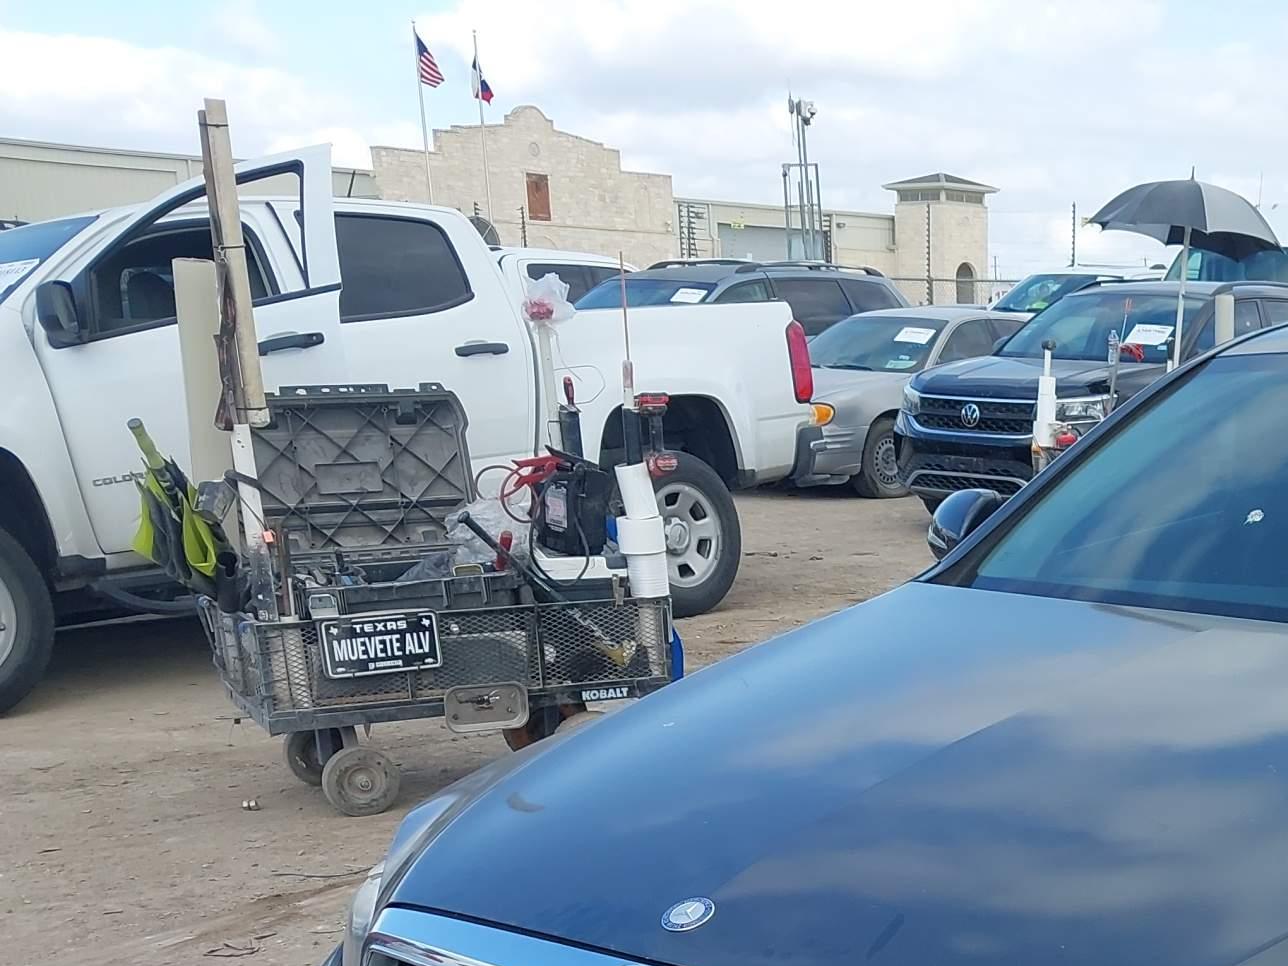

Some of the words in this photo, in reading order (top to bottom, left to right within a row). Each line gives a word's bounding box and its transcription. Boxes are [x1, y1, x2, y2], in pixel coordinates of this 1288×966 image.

[353, 620, 407, 633] TEXAS
[333, 634, 402, 661] MUEVETE
[405, 631, 430, 655] ALV
[581, 687, 629, 701] KOBALT
